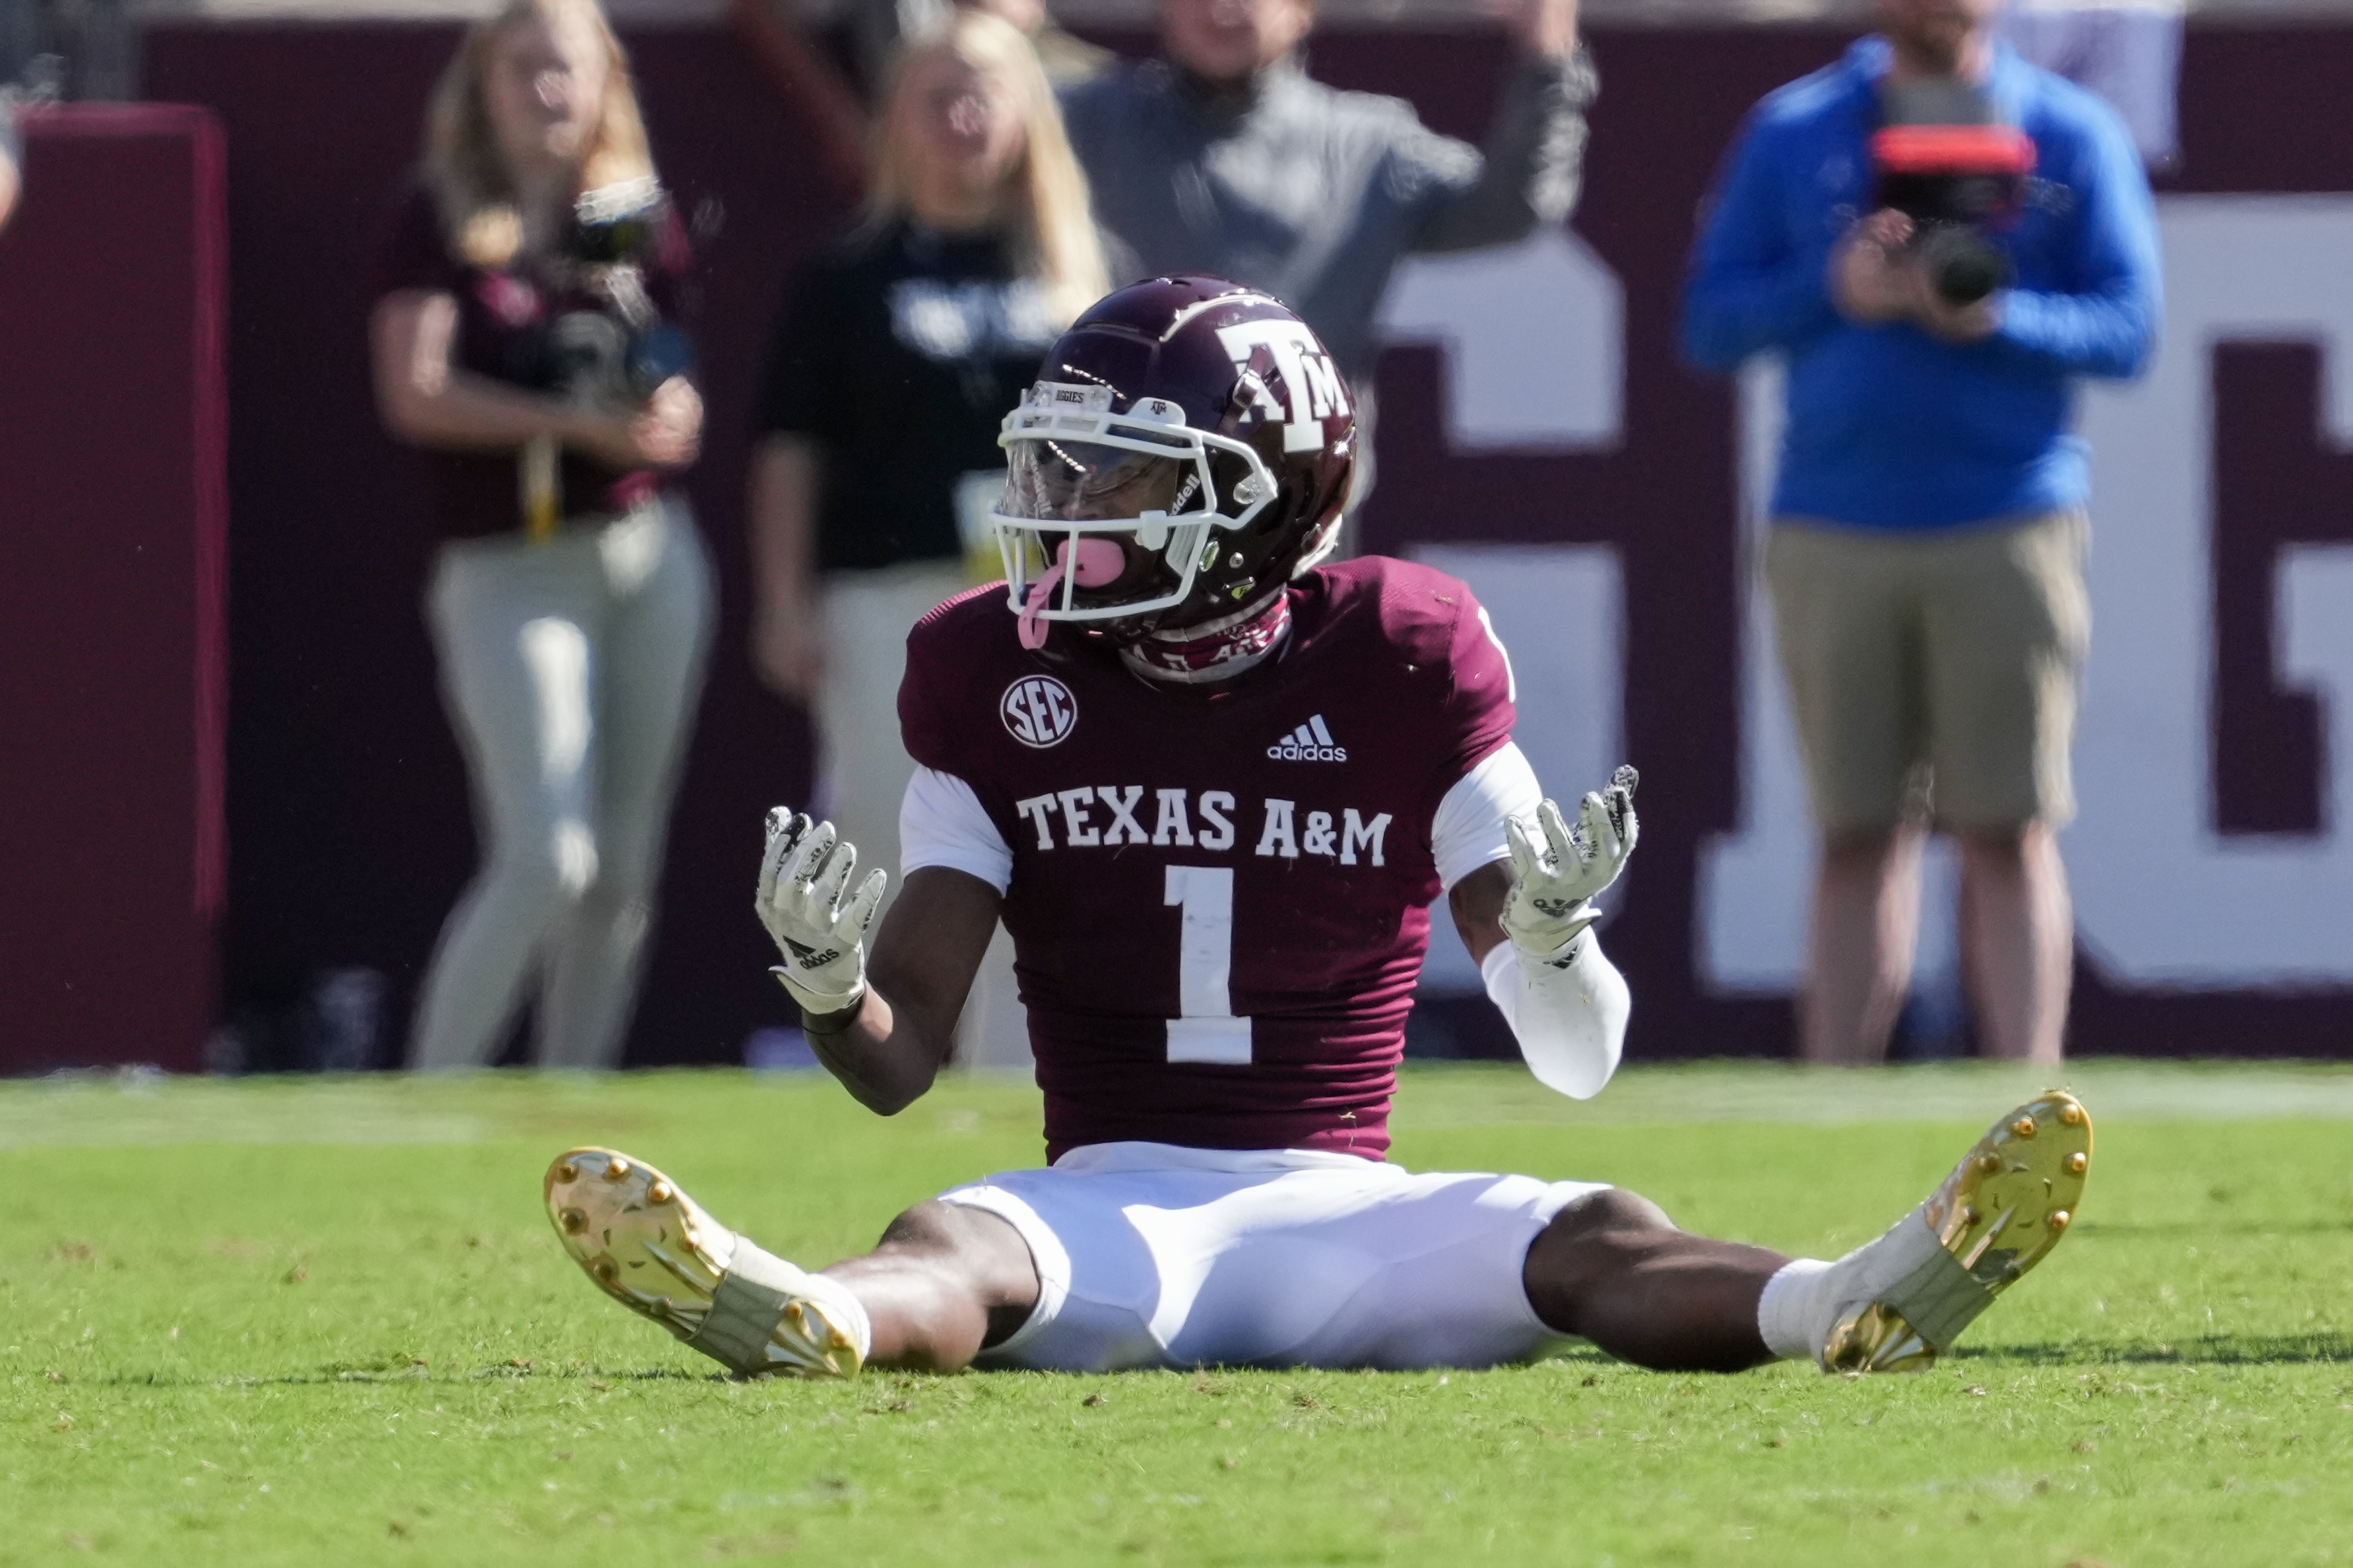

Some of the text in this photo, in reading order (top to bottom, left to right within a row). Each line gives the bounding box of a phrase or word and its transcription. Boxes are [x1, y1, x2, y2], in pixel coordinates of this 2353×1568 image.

[1007, 680, 1070, 741] SEC
[1267, 743, 1347, 762] adidas
[1016, 785, 1393, 867] TEXAS A&M
[1163, 865, 1252, 1065] 1
